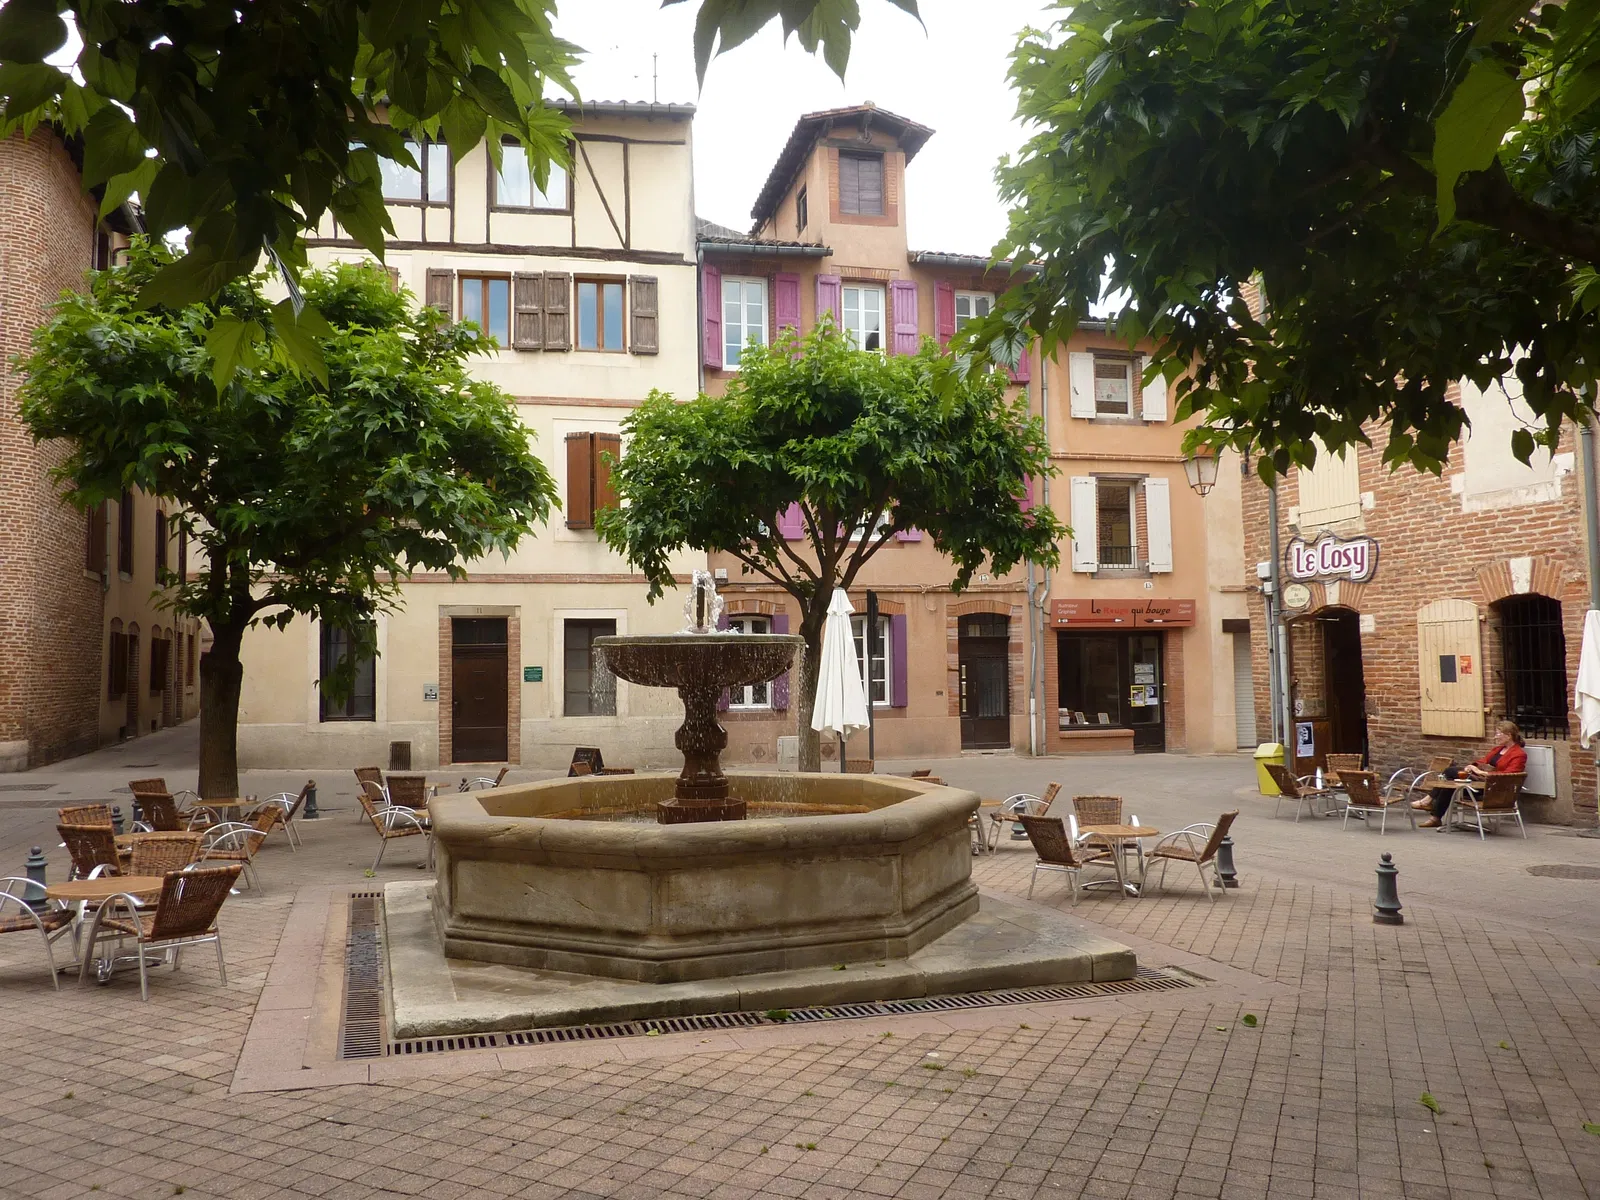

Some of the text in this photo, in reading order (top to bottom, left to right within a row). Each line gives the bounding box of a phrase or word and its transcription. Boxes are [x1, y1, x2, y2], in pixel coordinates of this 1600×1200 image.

[1321, 542, 1365, 574] Cosy
[1091, 599, 1102, 614] Le
[1131, 607, 1144, 627] qui
[1145, 599, 1171, 616] bouge
